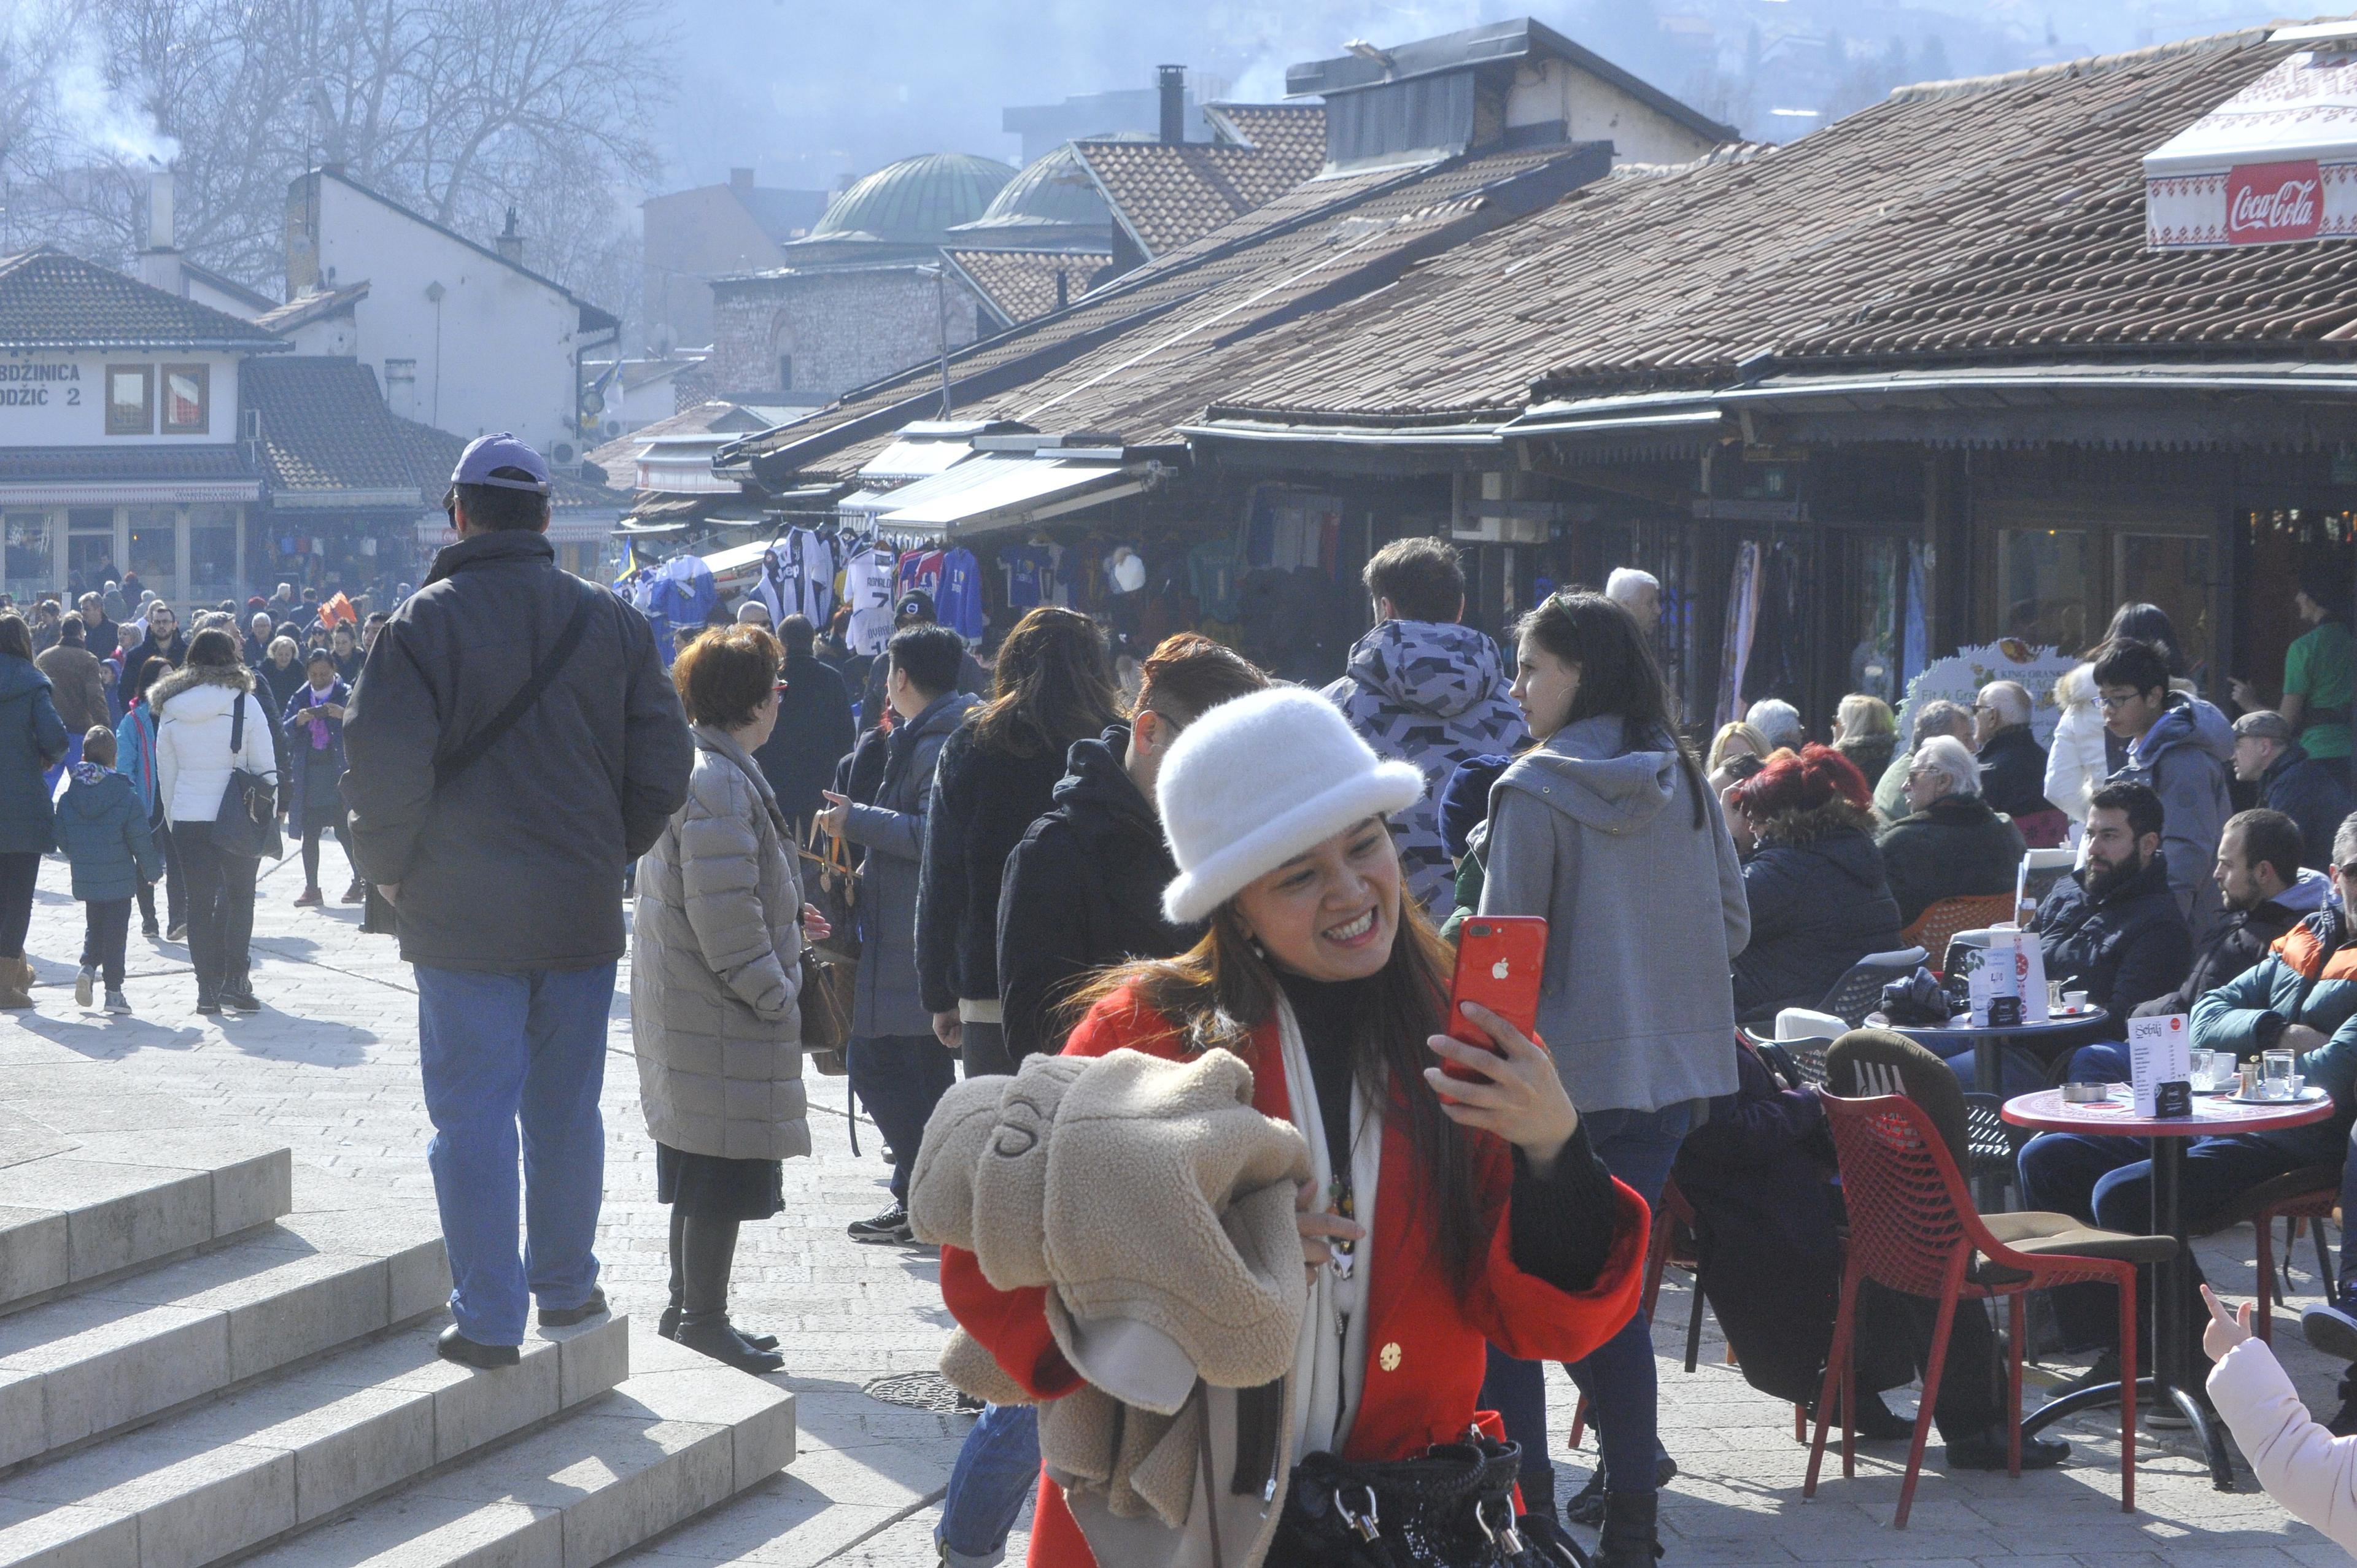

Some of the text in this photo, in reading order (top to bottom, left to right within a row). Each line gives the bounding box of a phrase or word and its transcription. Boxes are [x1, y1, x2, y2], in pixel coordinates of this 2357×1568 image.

[2231, 179, 2317, 231] Coca-Cola
[67, 388, 80, 406] 2
[867, 577, 891, 588] RONALD
[872, 592, 889, 608] 7
[1922, 689, 1937, 700] Fit
[1941, 690, 1951, 700] &
